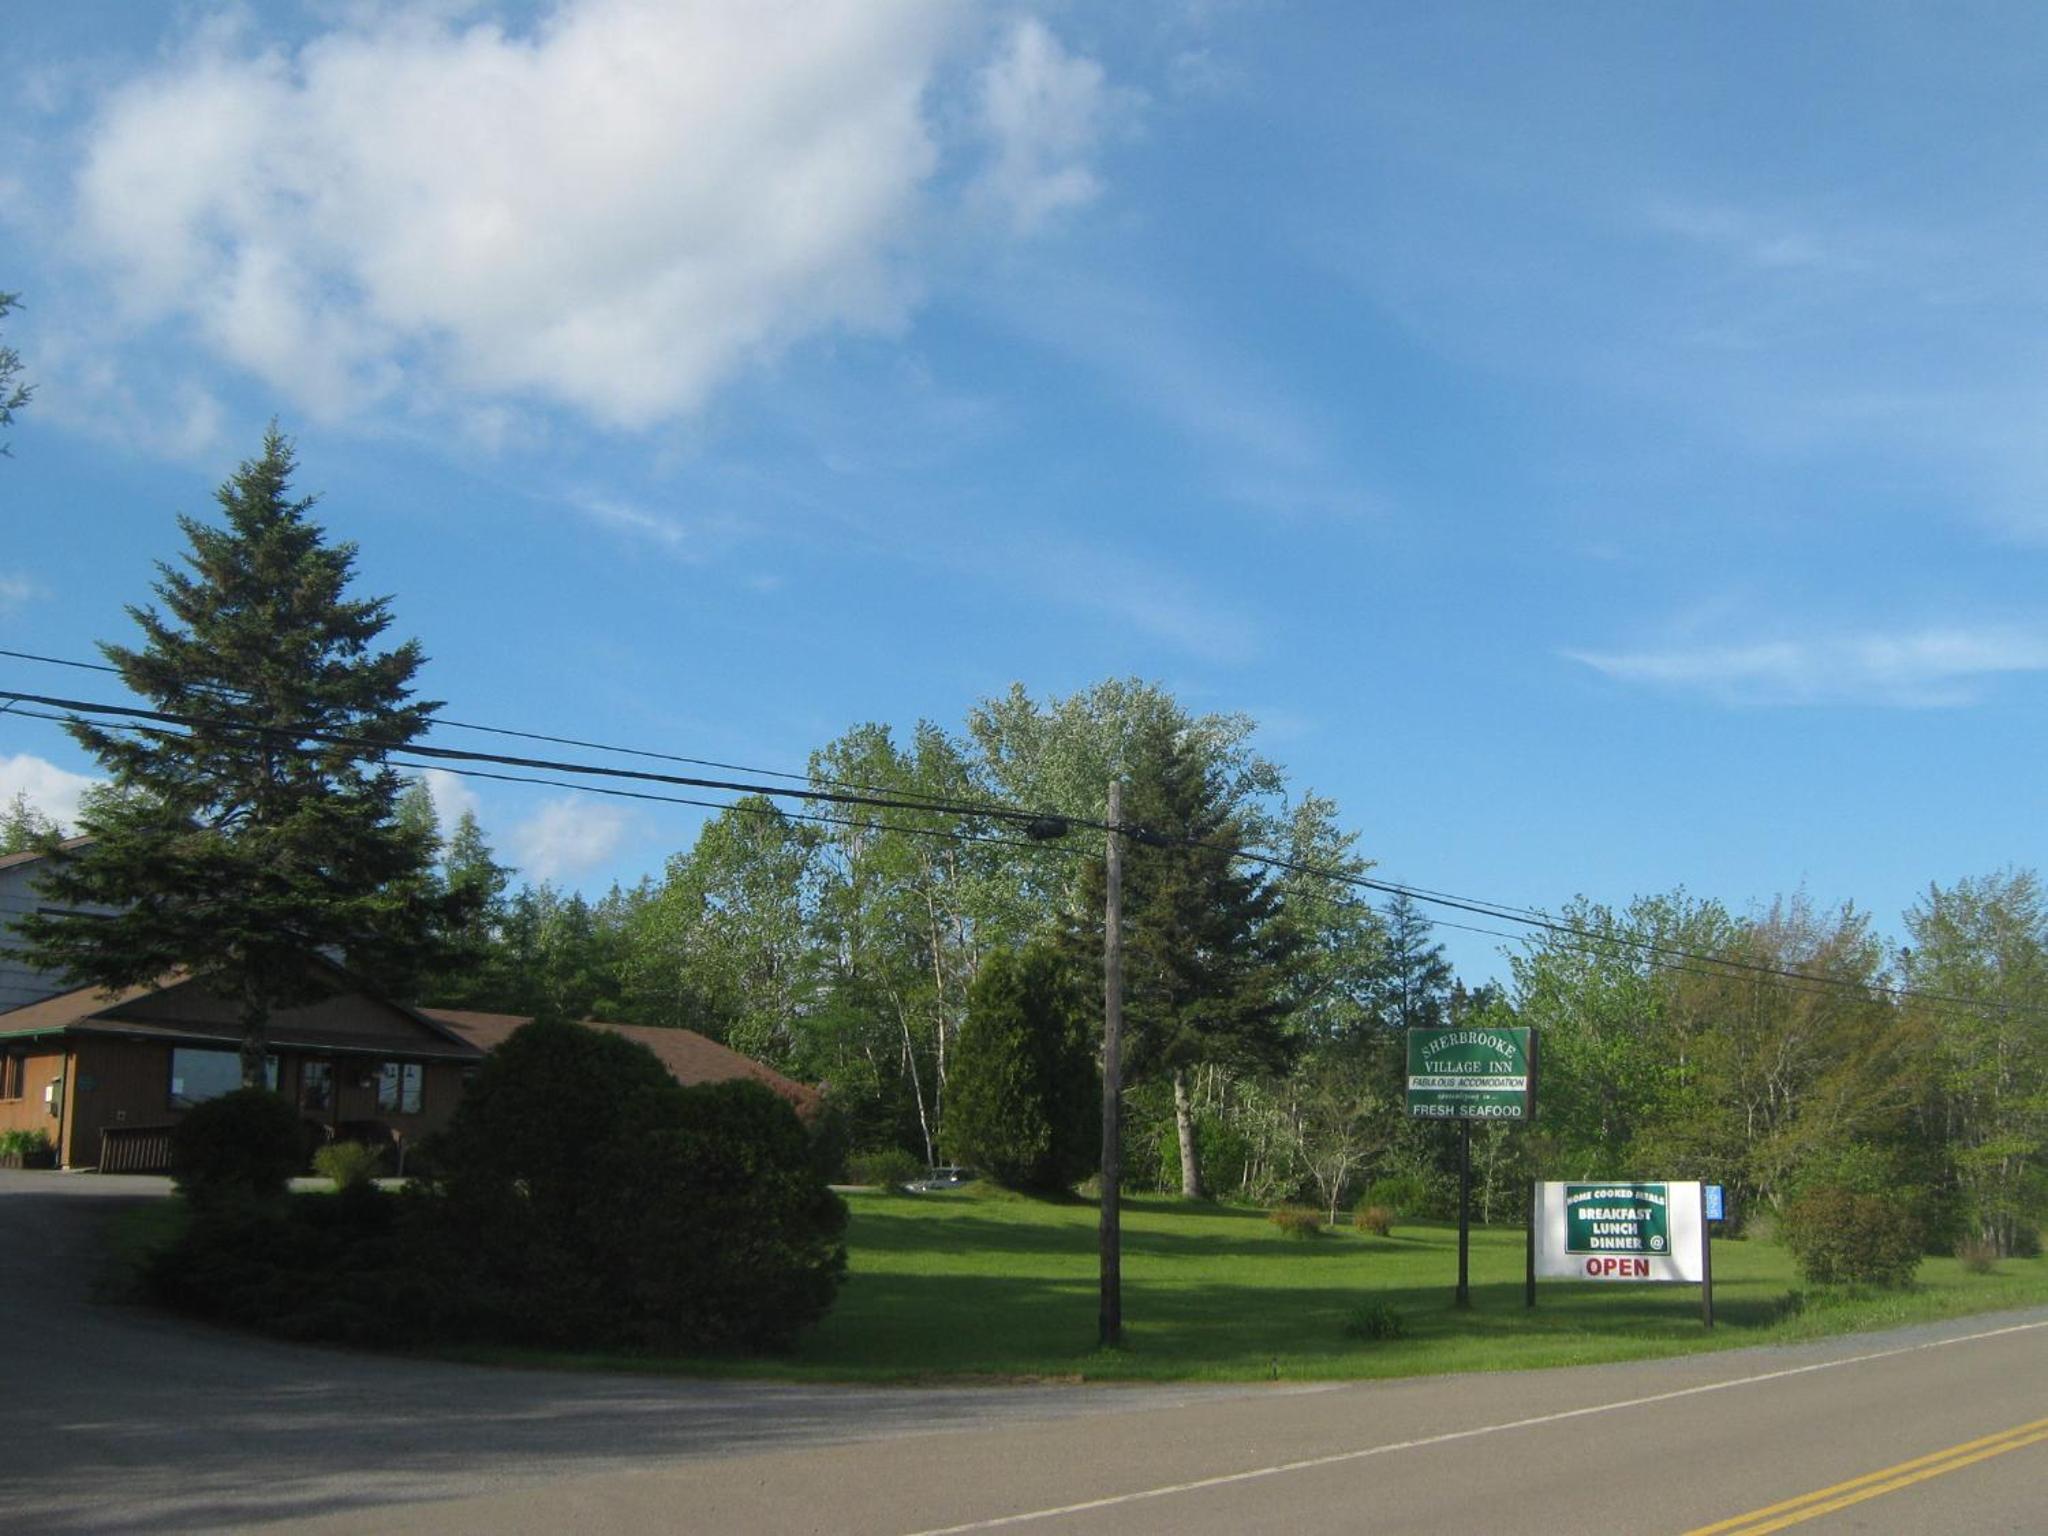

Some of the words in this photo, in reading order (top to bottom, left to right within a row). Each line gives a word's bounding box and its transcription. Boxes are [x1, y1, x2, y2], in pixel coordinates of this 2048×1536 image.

[1421, 1031, 1516, 1059] SHERBROOKE
[1425, 1061, 1481, 1073] VILLAGE
[1489, 1061, 1513, 1073] INN
[1413, 1104, 1455, 1116] FRESH
[1459, 1105, 1522, 1117] SEAFOOD
[1567, 1191, 1592, 1205] HOME
[1594, 1188, 1633, 1199] COOKED
[1635, 1191, 1665, 1206] MEALS
[1578, 1208, 1652, 1220] BREAKFAST
[1593, 1223, 1638, 1235] LUNCH
[1590, 1237, 1642, 1249] DINNER
[1586, 1258, 1650, 1276] OPEN
